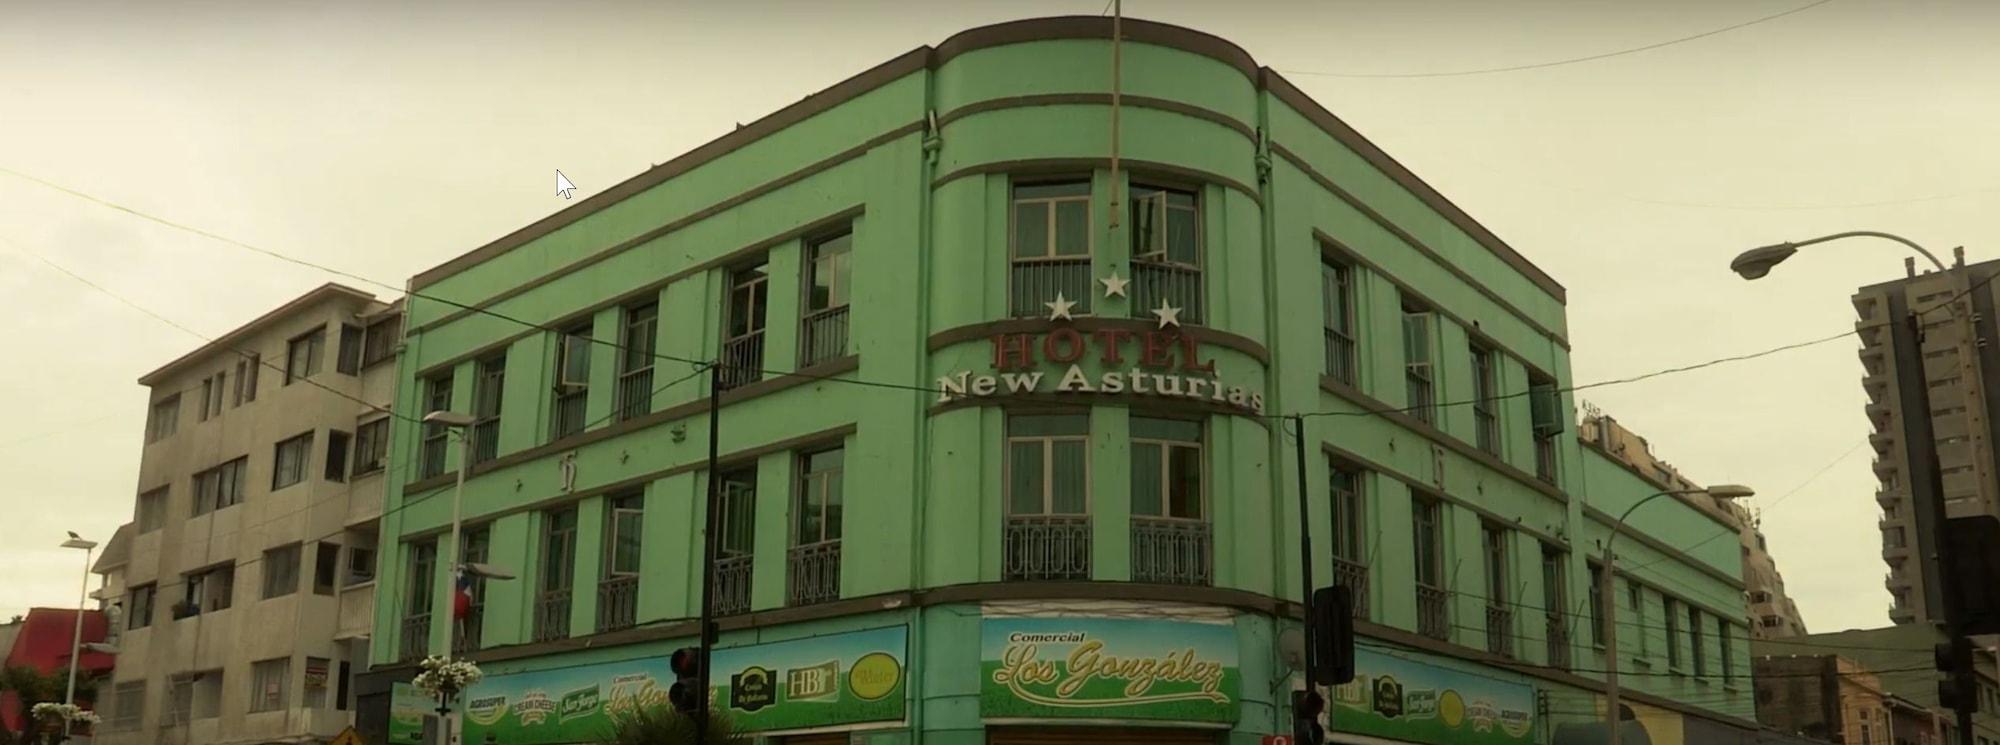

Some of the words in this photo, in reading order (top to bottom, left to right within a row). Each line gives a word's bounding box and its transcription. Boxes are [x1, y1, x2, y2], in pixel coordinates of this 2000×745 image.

[990, 328, 1215, 372] HOTEL
[937, 370, 1044, 403] New
[1056, 364, 1266, 416] Asturias
[1010, 631, 1087, 644] Comercial
[994, 644, 1059, 685] Los
[1056, 640, 1223, 698] González
